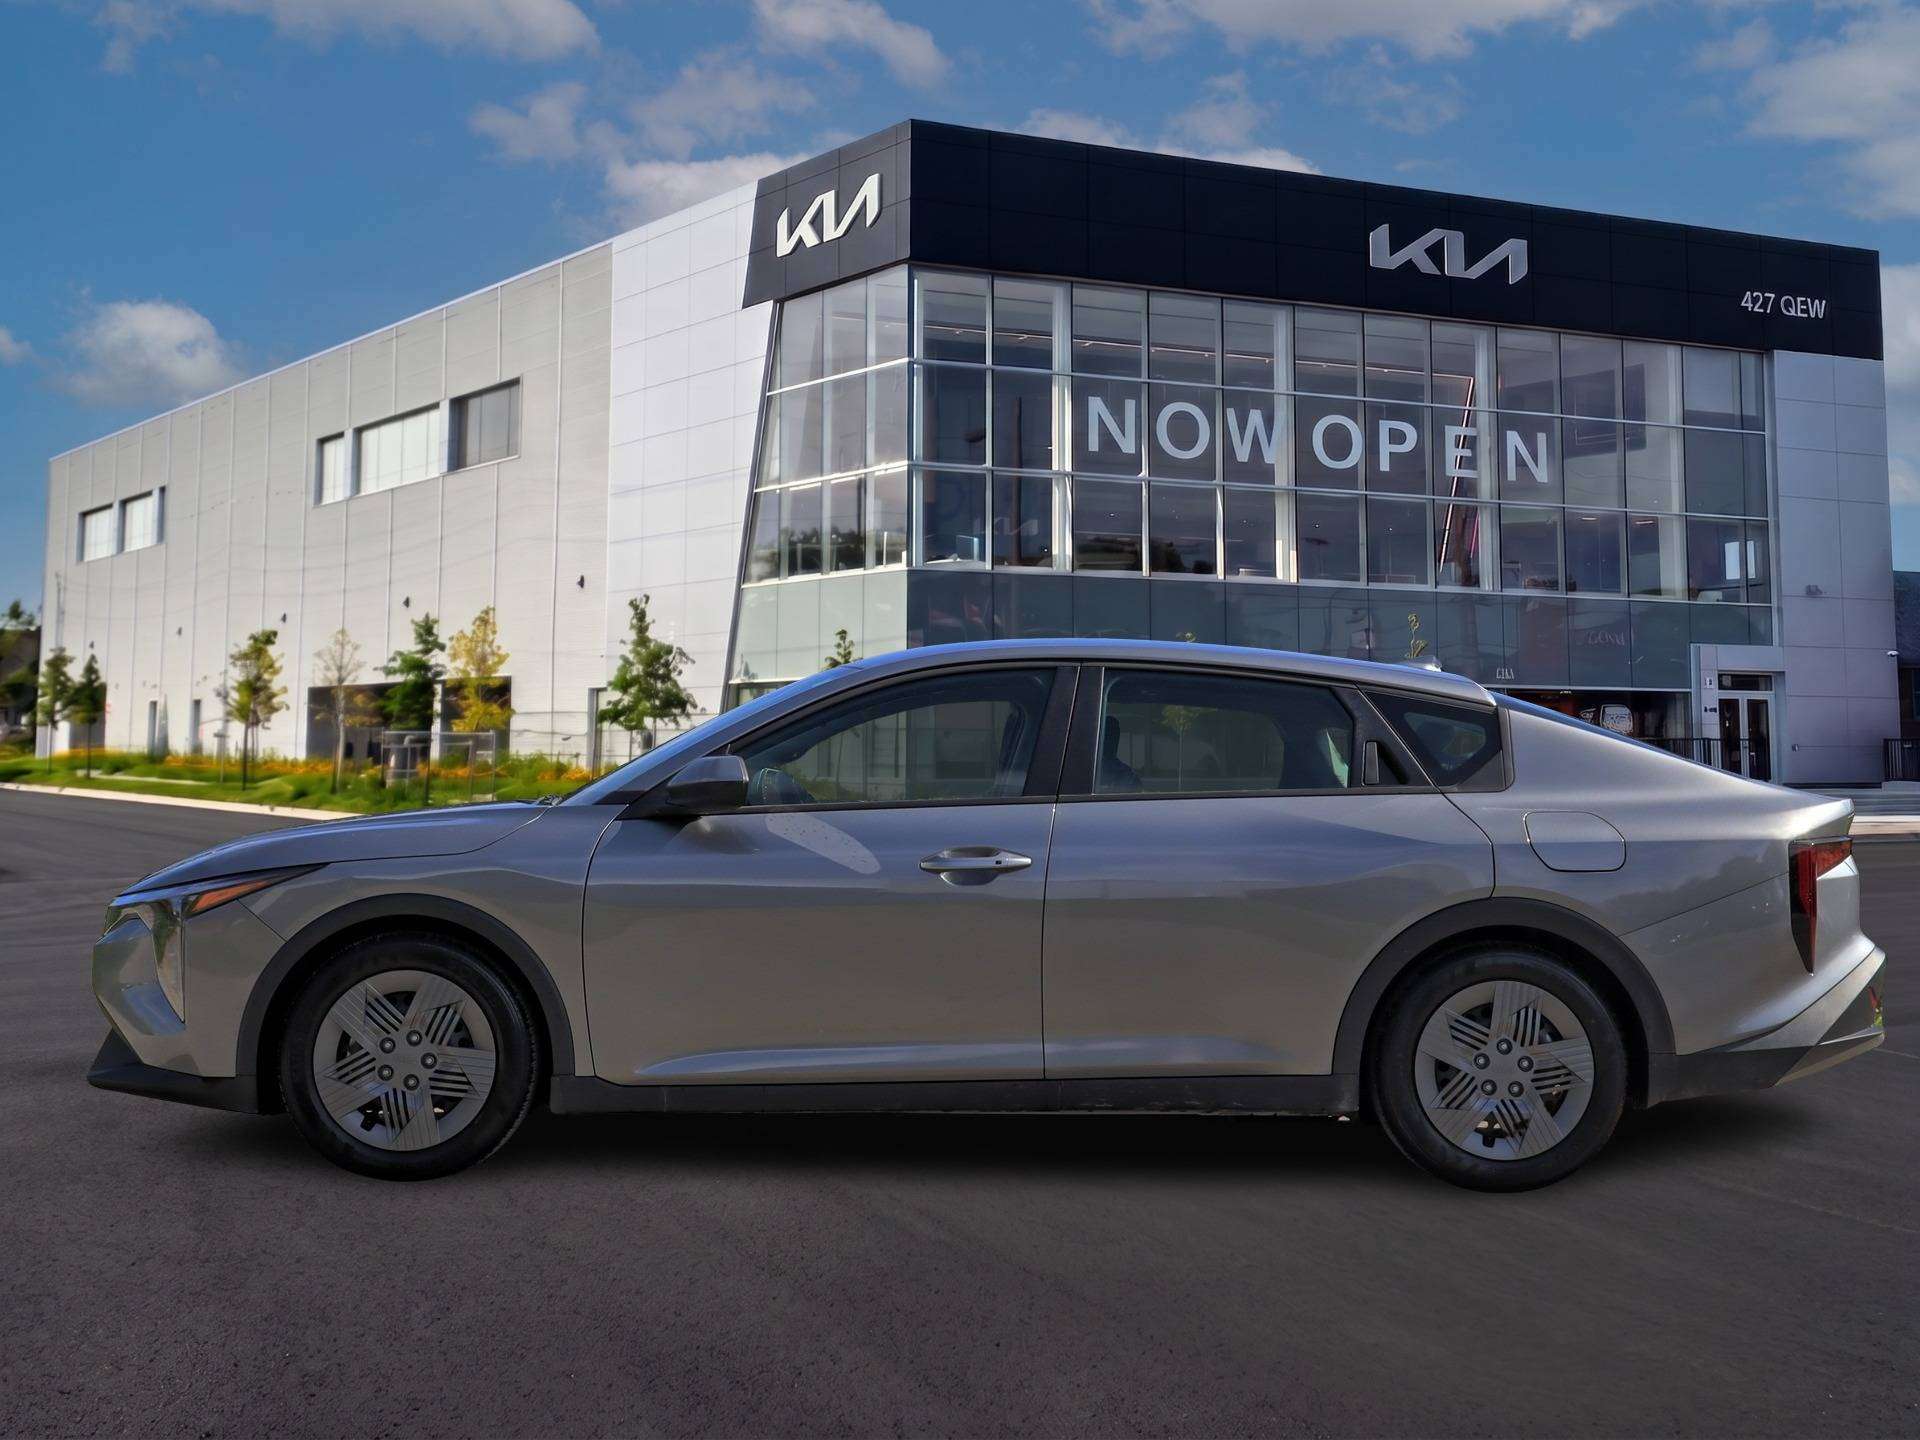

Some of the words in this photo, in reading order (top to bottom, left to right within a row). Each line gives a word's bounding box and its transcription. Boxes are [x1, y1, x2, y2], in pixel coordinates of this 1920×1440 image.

[776, 172, 881, 258] KIA
[1369, 223, 1529, 285] KIA
[1740, 290, 1776, 314] 427
[1780, 295, 1827, 319] QEW
[1086, 395, 1287, 465] NOW
[1311, 413, 1549, 484] OPEN
